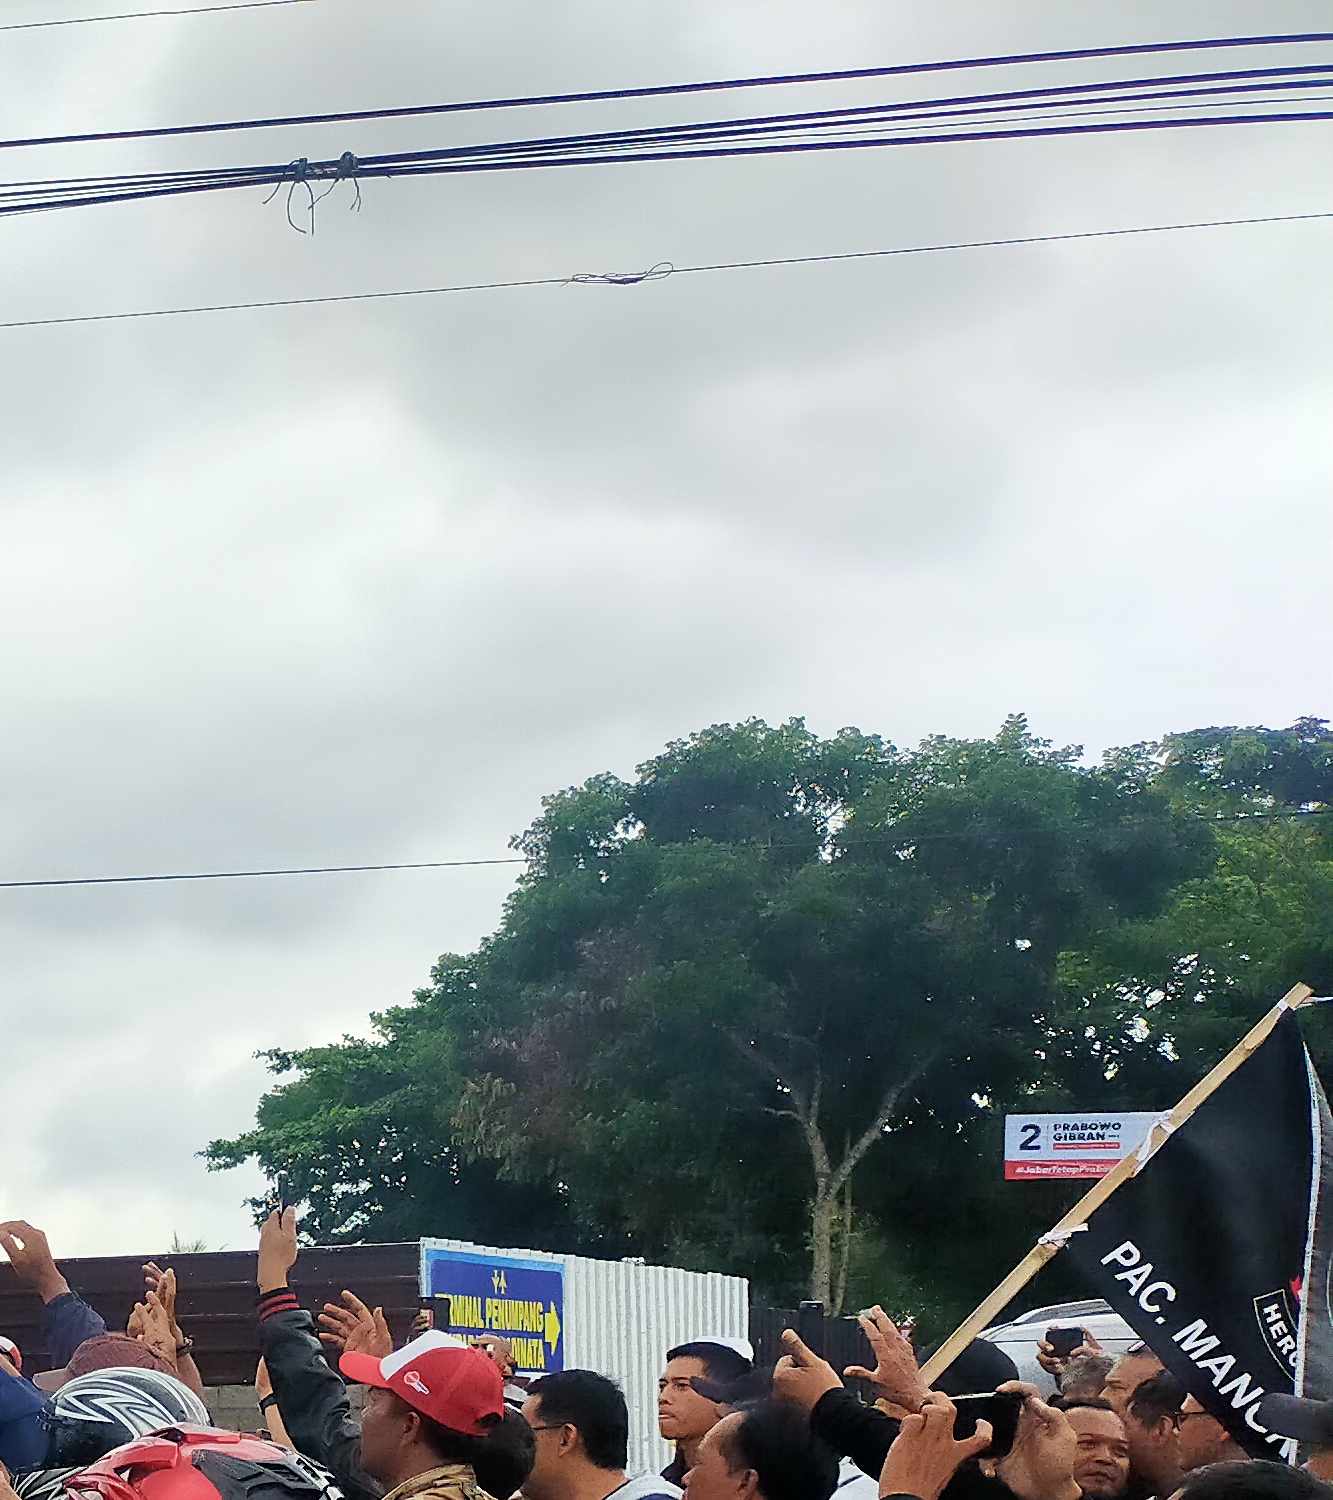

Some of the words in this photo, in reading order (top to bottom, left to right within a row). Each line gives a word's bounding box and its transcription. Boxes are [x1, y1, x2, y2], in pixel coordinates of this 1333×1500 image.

[1019, 1123, 1042, 1151] 2
[1053, 1122, 1122, 1132] PRABOWO
[1053, 1132, 1106, 1142] GIBRAN
[1100, 1240, 1176, 1325] PAC.
[486, 1298, 544, 1333] PENUMPANG
